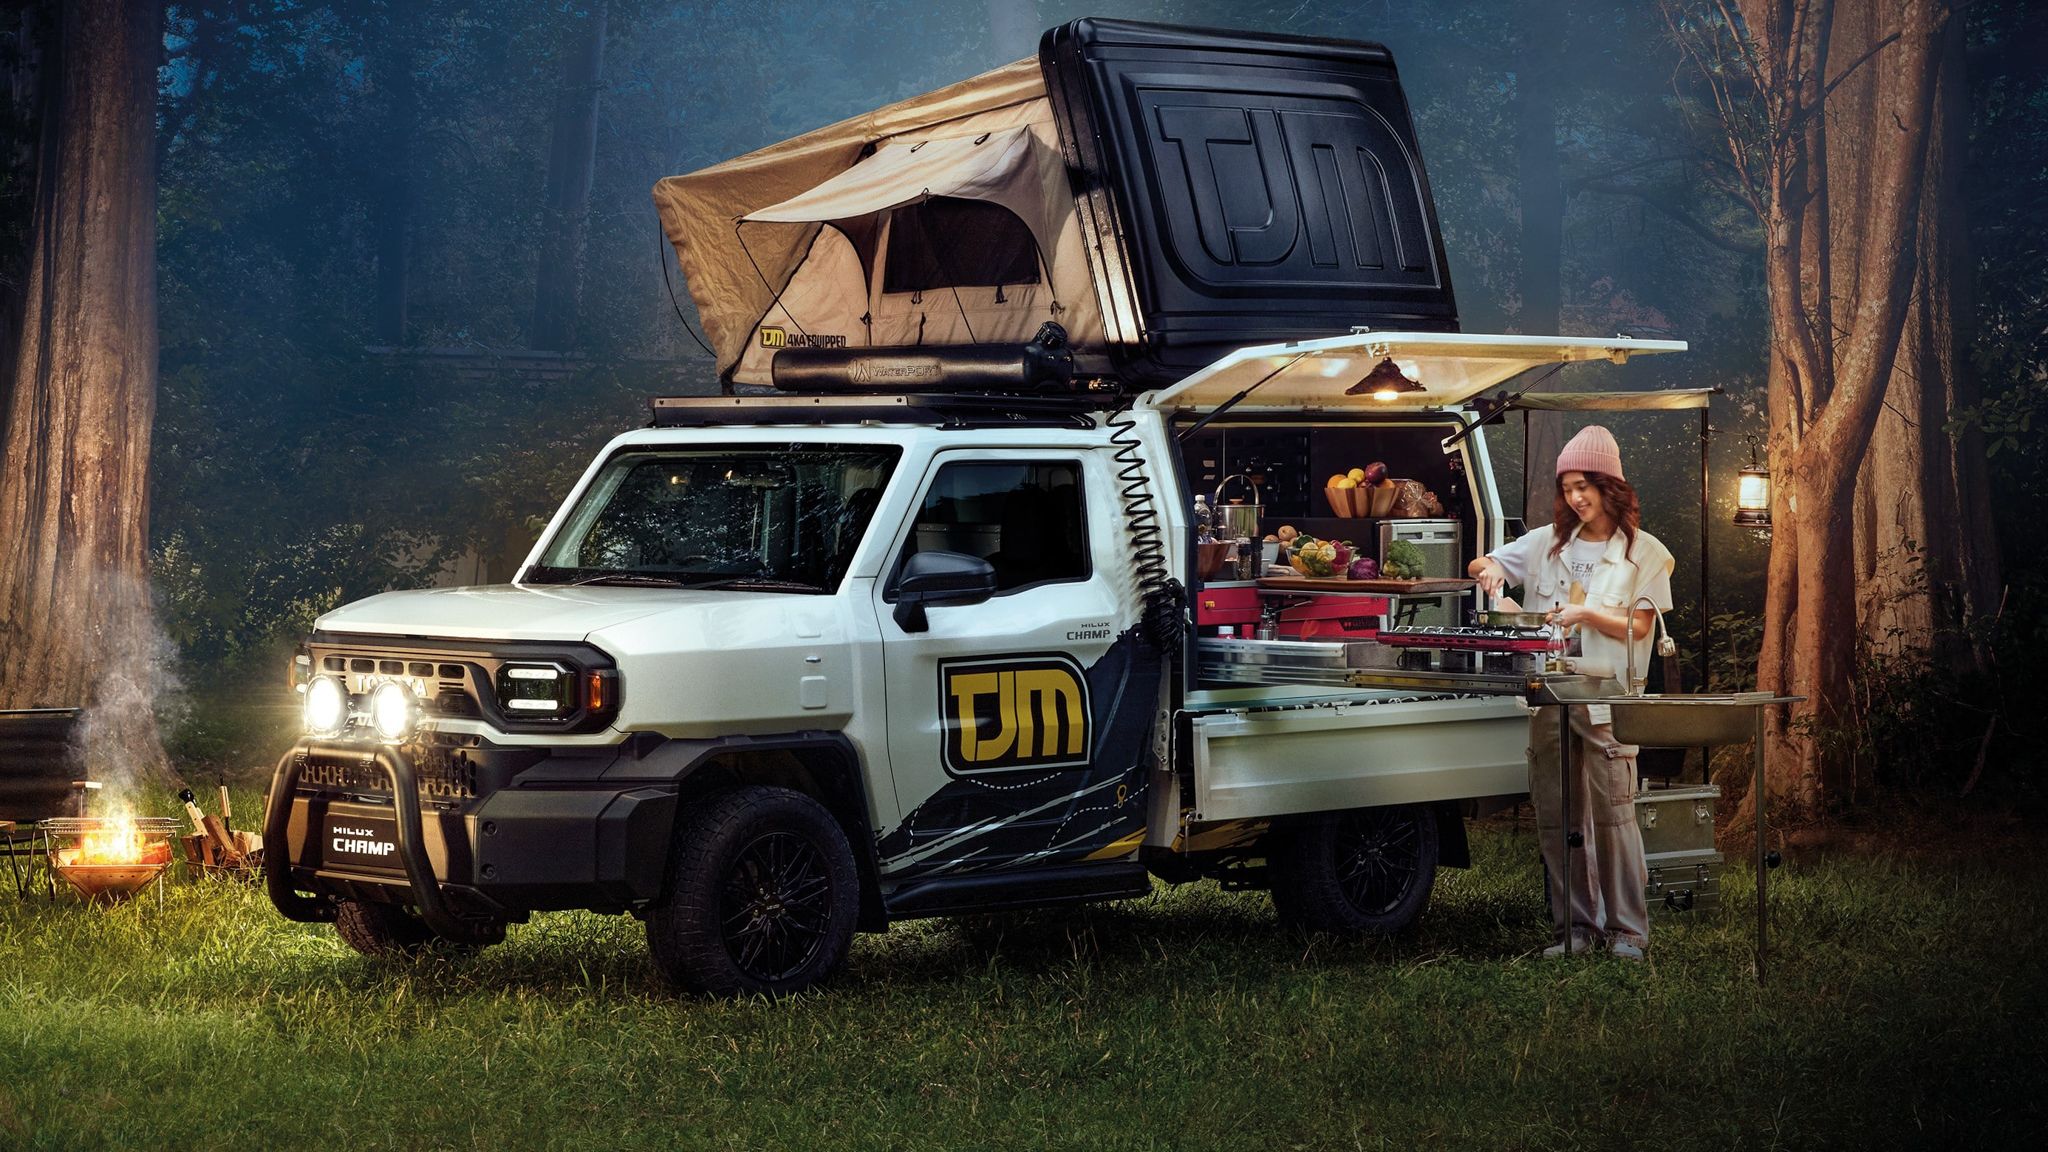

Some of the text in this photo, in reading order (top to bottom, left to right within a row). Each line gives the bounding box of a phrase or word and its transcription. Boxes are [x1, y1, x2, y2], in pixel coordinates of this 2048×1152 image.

[1154, 104, 1425, 272] TJM
[761, 328, 785, 347] TJM
[807, 334, 847, 348] EQUIPPED
[1066, 630, 1110, 640] CHAMP
[356, 675, 428, 697] TOTA
[951, 669, 1083, 762] TJM
[333, 827, 374, 837] HILUX
[333, 838, 395, 856] CHAMP
